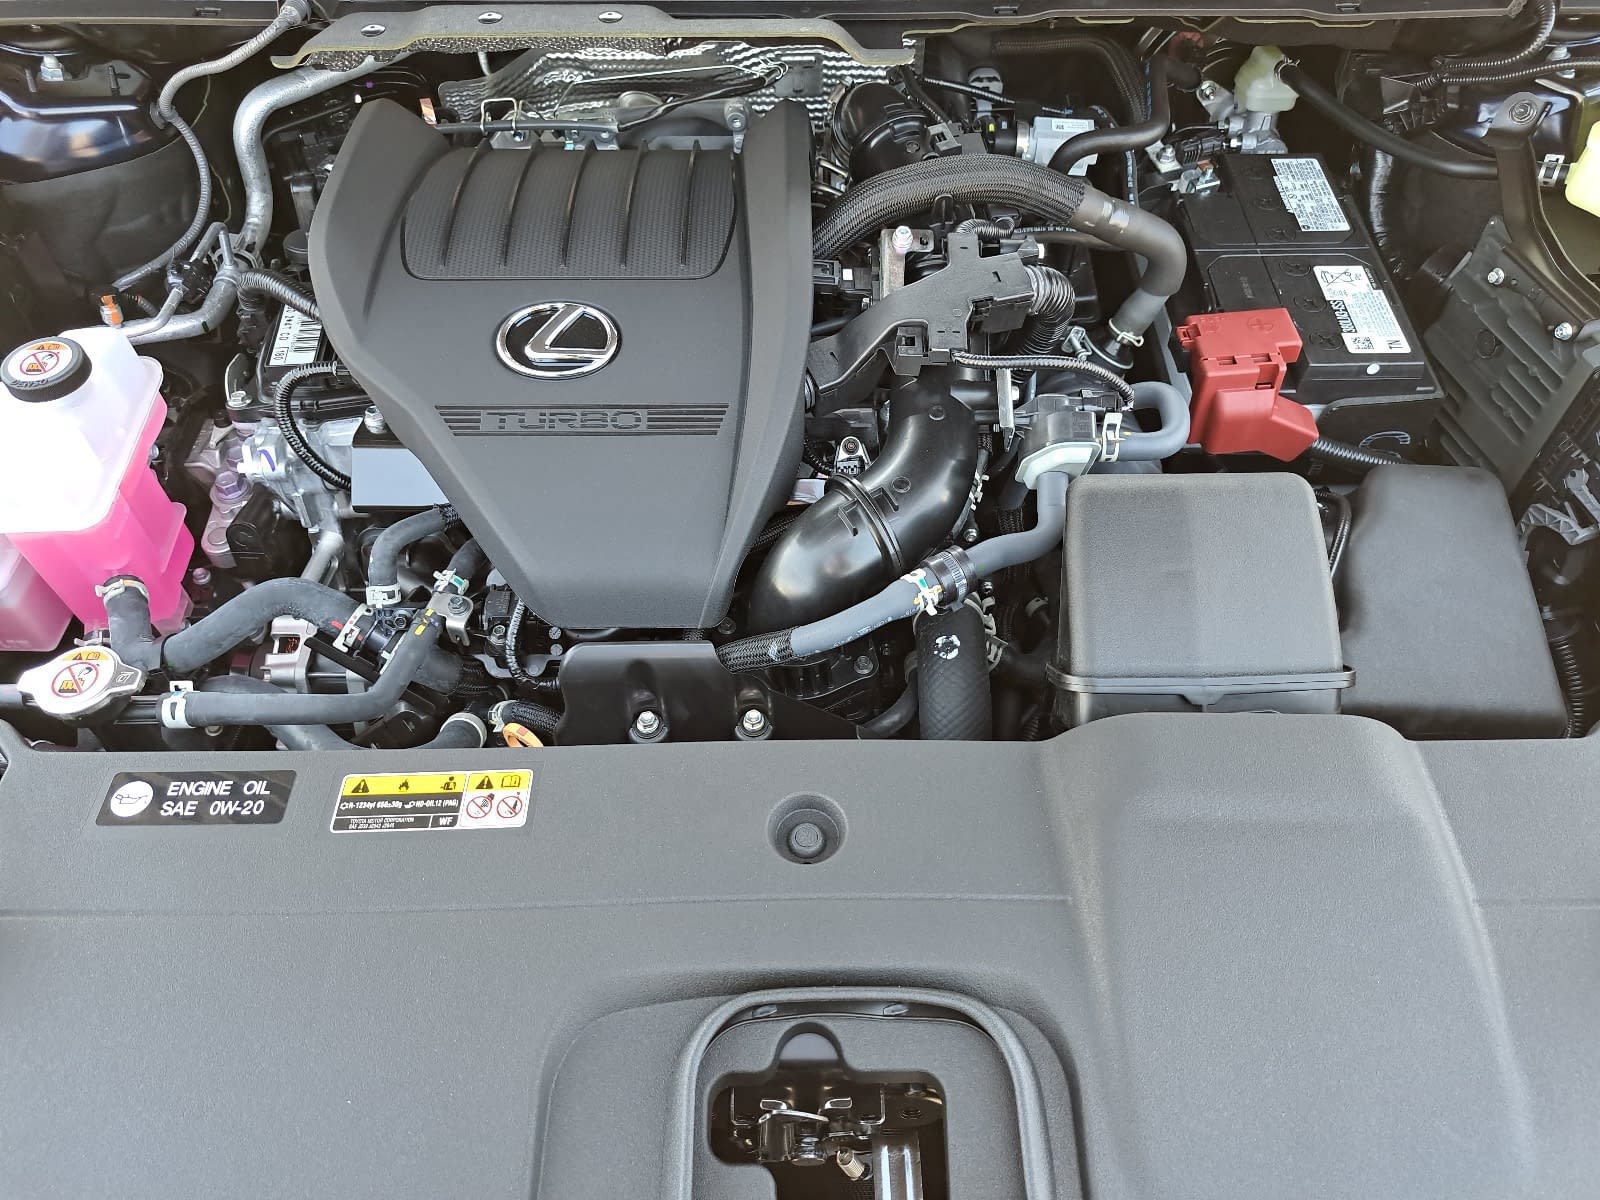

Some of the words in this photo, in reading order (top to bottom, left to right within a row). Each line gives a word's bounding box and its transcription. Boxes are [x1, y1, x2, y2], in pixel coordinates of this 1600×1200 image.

[483, 409, 643, 430] TURBO
[167, 781, 233, 796] ENGINE
[244, 781, 271, 795] OIL
[160, 801, 199, 816] SAE
[209, 800, 264, 815] 0W-20
[439, 816, 453, 825] WF
